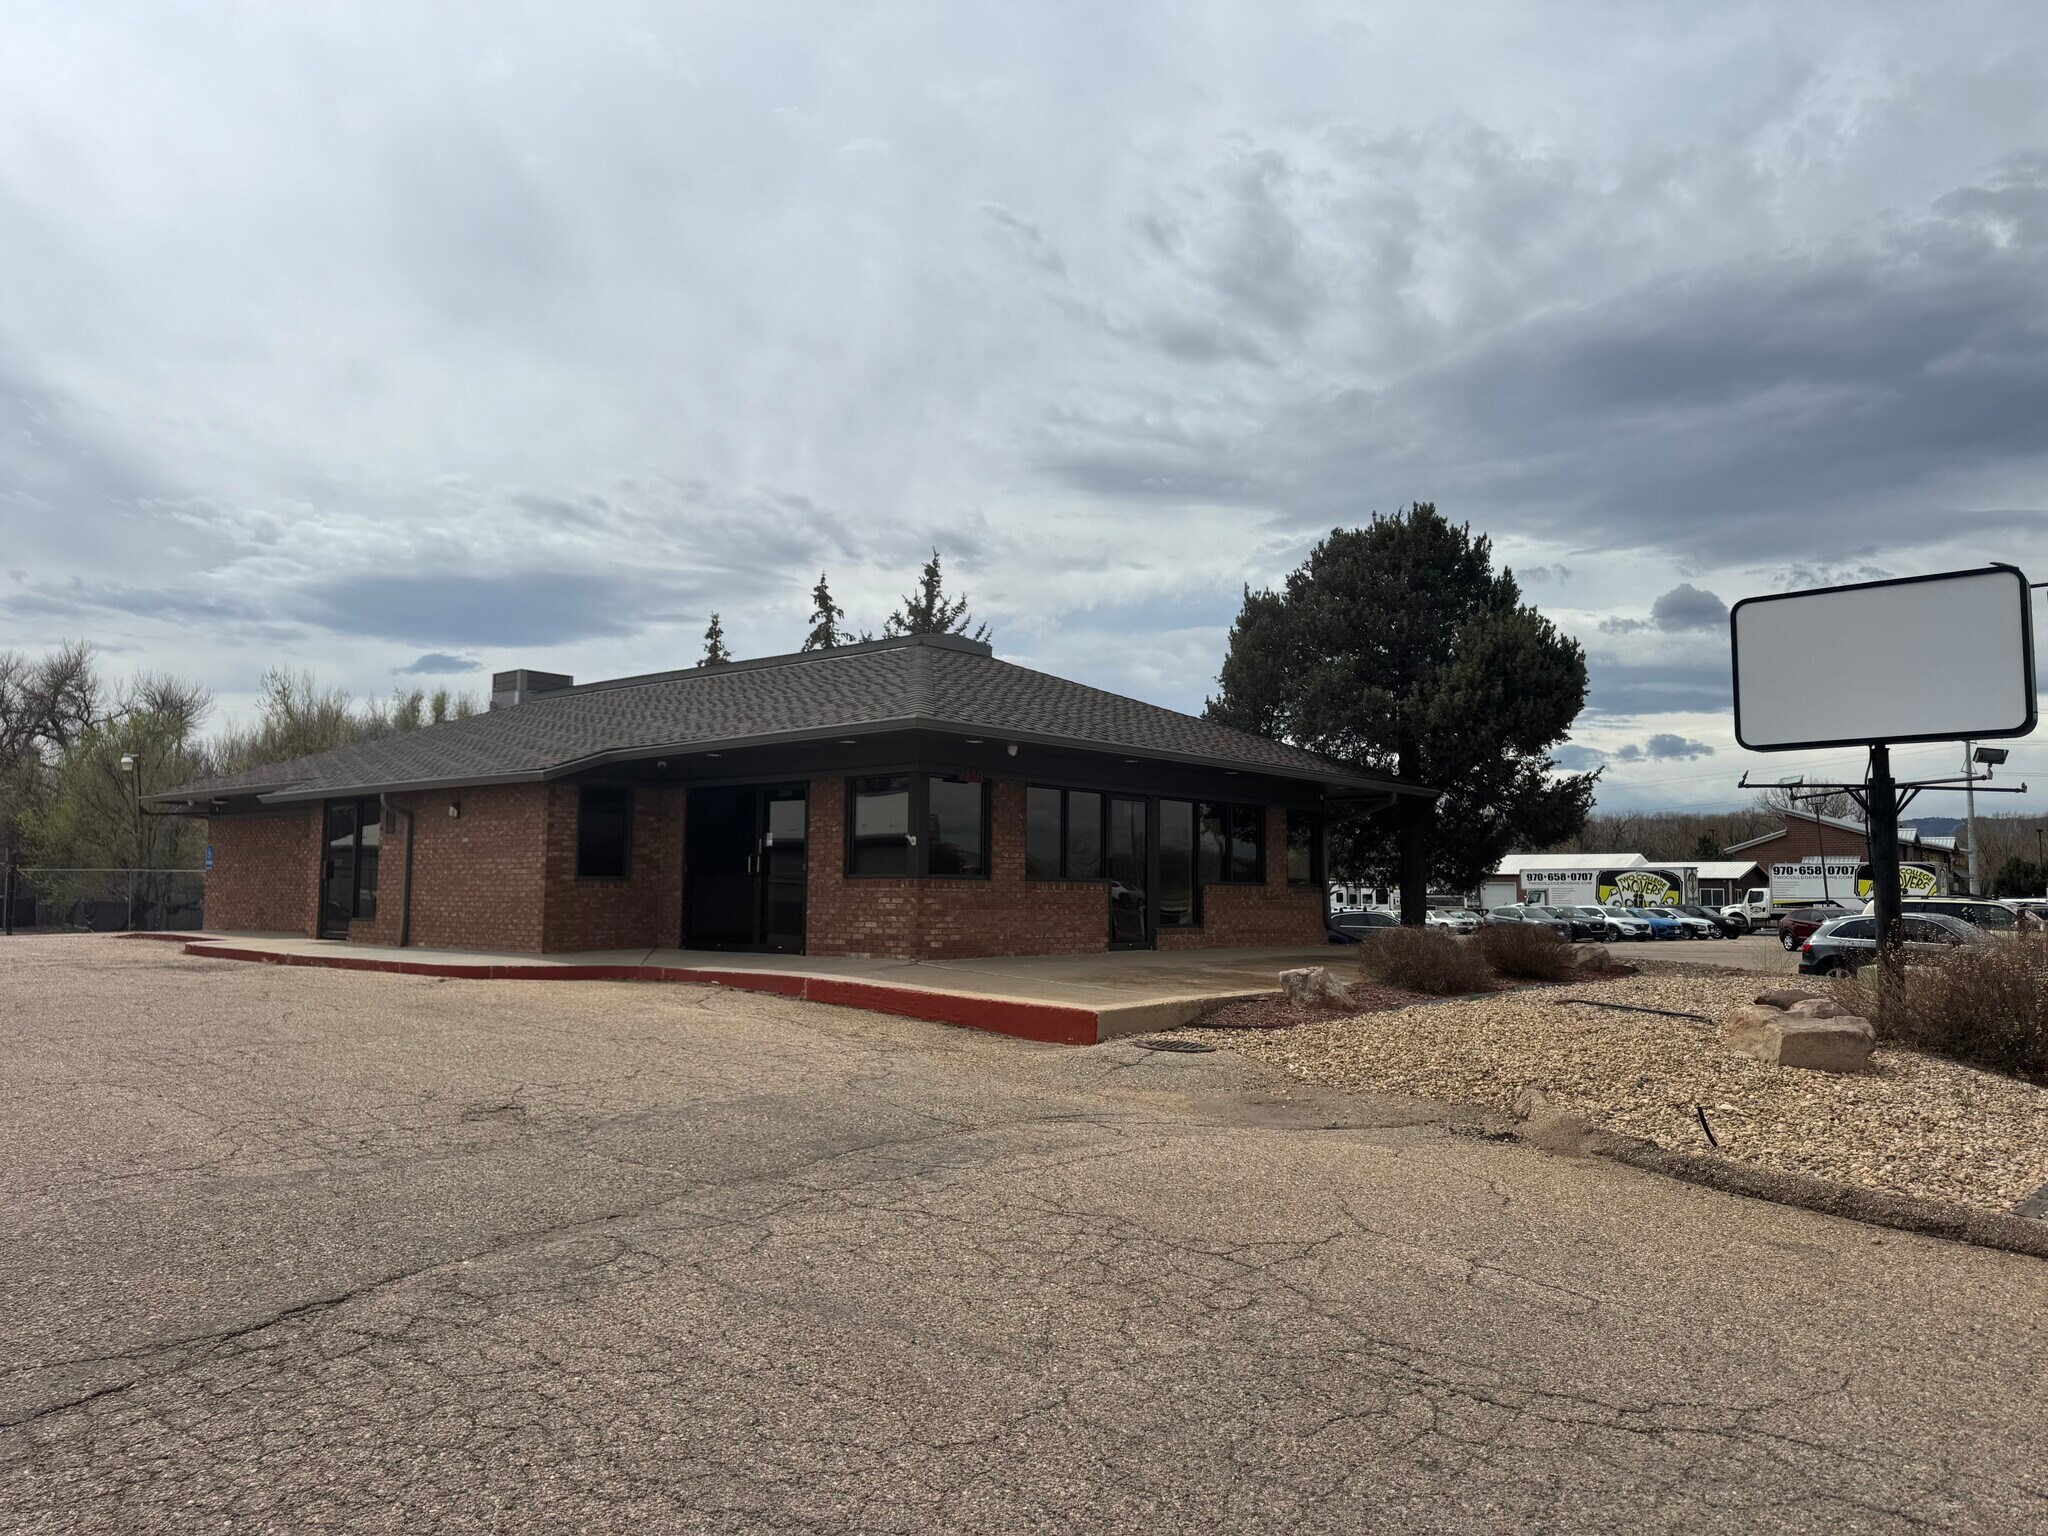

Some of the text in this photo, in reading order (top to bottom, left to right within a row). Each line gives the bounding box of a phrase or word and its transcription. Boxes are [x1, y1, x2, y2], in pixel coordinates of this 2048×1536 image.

[1617, 873, 1668, 889] TWO COLLEGE
[1899, 867, 1935, 884] COLLEGE
[1899, 874, 1930, 890] VERS
[1621, 879, 1664, 896] MOVERS
